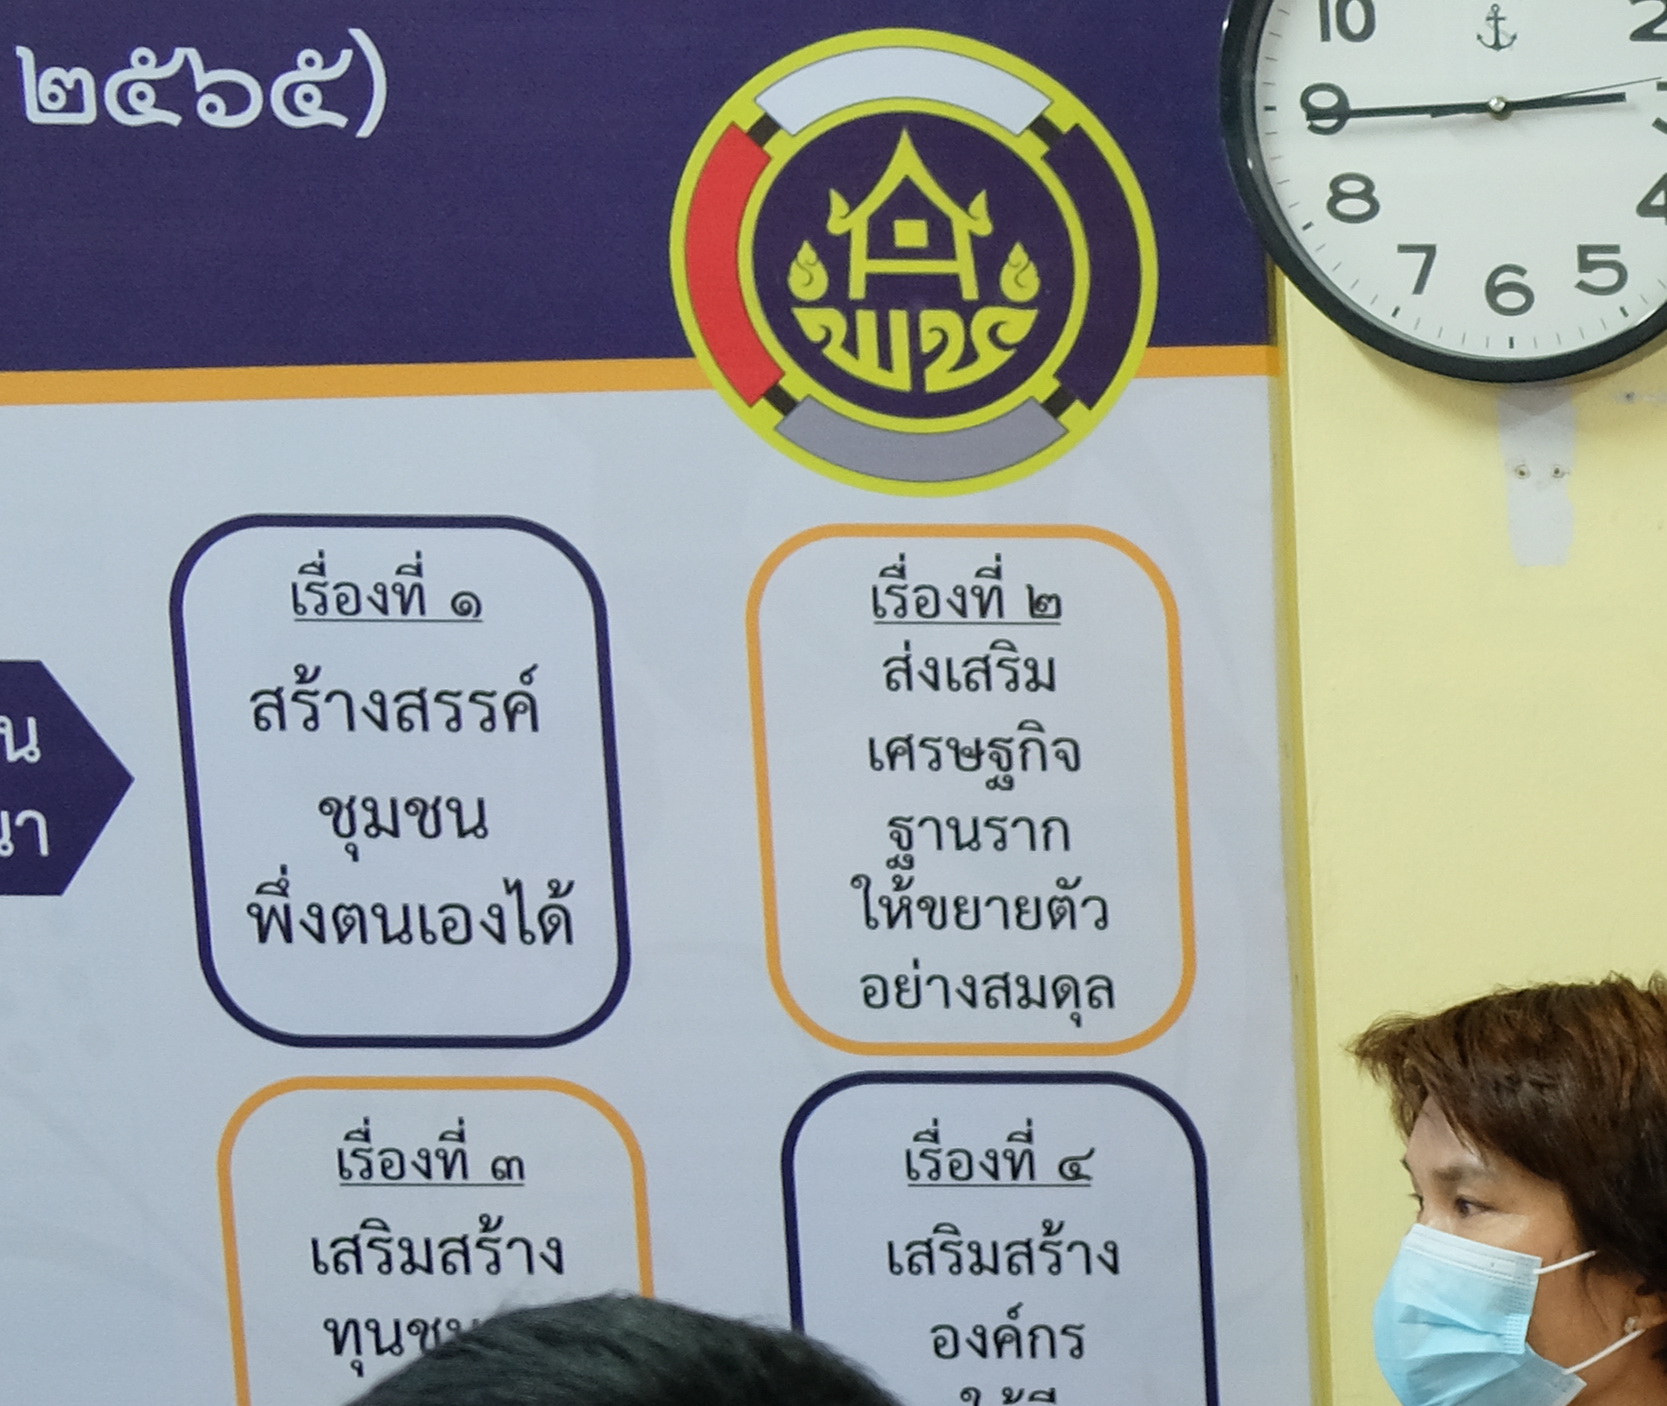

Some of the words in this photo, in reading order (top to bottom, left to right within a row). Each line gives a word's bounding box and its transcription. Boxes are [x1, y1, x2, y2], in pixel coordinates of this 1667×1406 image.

[16, 28, 387, 138] ๒๕๖๕)
[1327, 173, 1380, 223] 8
[1397, 244, 1436, 295] 7
[1485, 264, 1534, 316] 6
[1575, 245, 1628, 295] 5
[292, 550, 426, 616] เรื่องที่
[451, 591, 482, 618] ๑
[872, 553, 1004, 622] เรื่องที่
[1026, 584, 1062, 619] ๒
[883, 639, 1055, 692] ส่งเสริม
[250, 664, 539, 732] สร้างสรรค์
[869, 719, 1080, 791] เศรษฐกิจ
[318, 795, 488, 862] ชุมชน
[886, 816, 1070, 870] ฐานราก
[247, 859, 574, 945] พึ่งตนเองได้
[850, 874, 1108, 930] ให้ขยายตัว
[860, 958, 1115, 1028] อย่างสมดุล
[338, 1117, 468, 1180] เรื่องที่
[491, 1156, 525, 1181] ๓
[906, 1118, 1035, 1181] เรื่องที่
[1058, 1147, 1095, 1181] ๔
[311, 1213, 564, 1275] เสริมสร้าง
[888, 1219, 1119, 1276] เสริมสร้าง
[931, 1302, 1085, 1359] องค์กร
